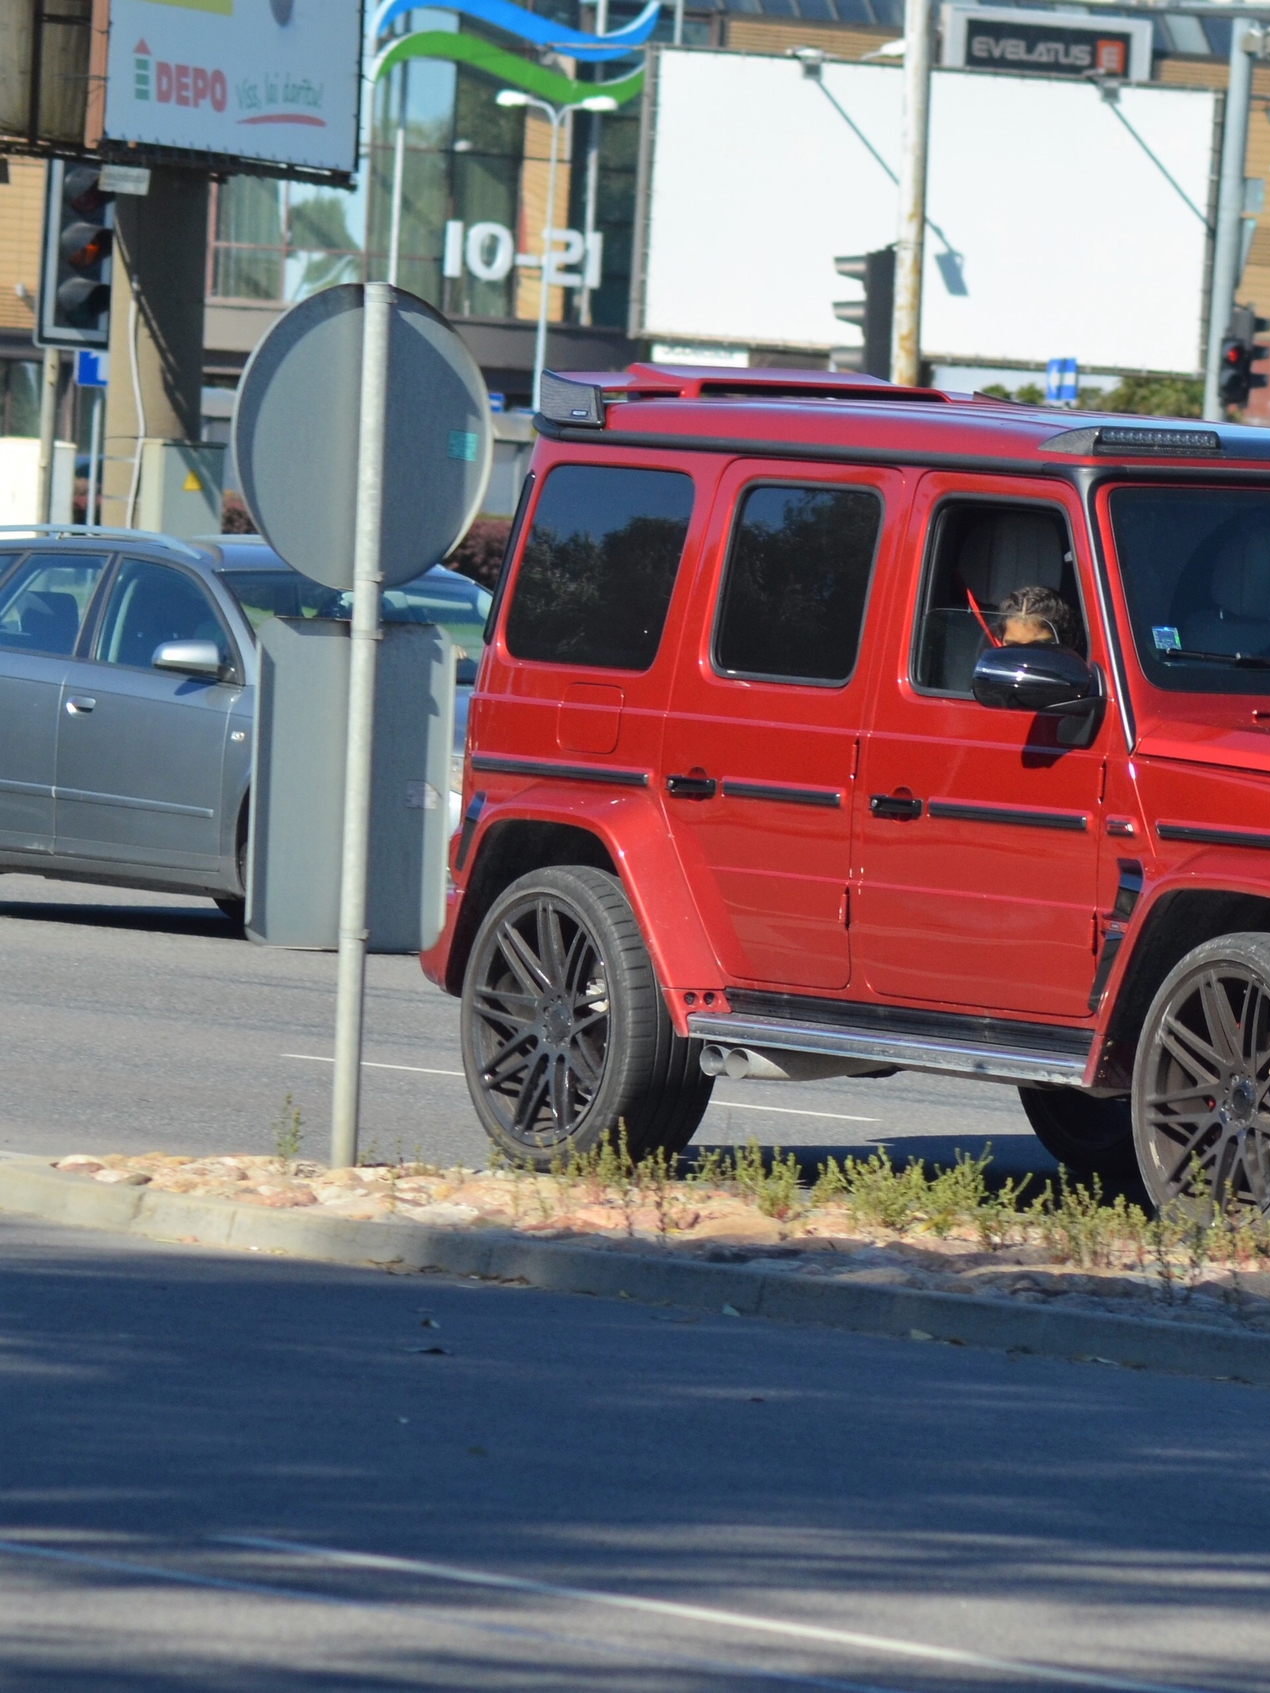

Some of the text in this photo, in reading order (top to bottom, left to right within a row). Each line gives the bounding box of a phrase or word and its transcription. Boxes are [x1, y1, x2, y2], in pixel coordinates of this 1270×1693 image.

[971, 36, 1092, 67] EVELATUS
[156, 61, 227, 113] DEPO
[443, 219, 604, 290] 10-21
